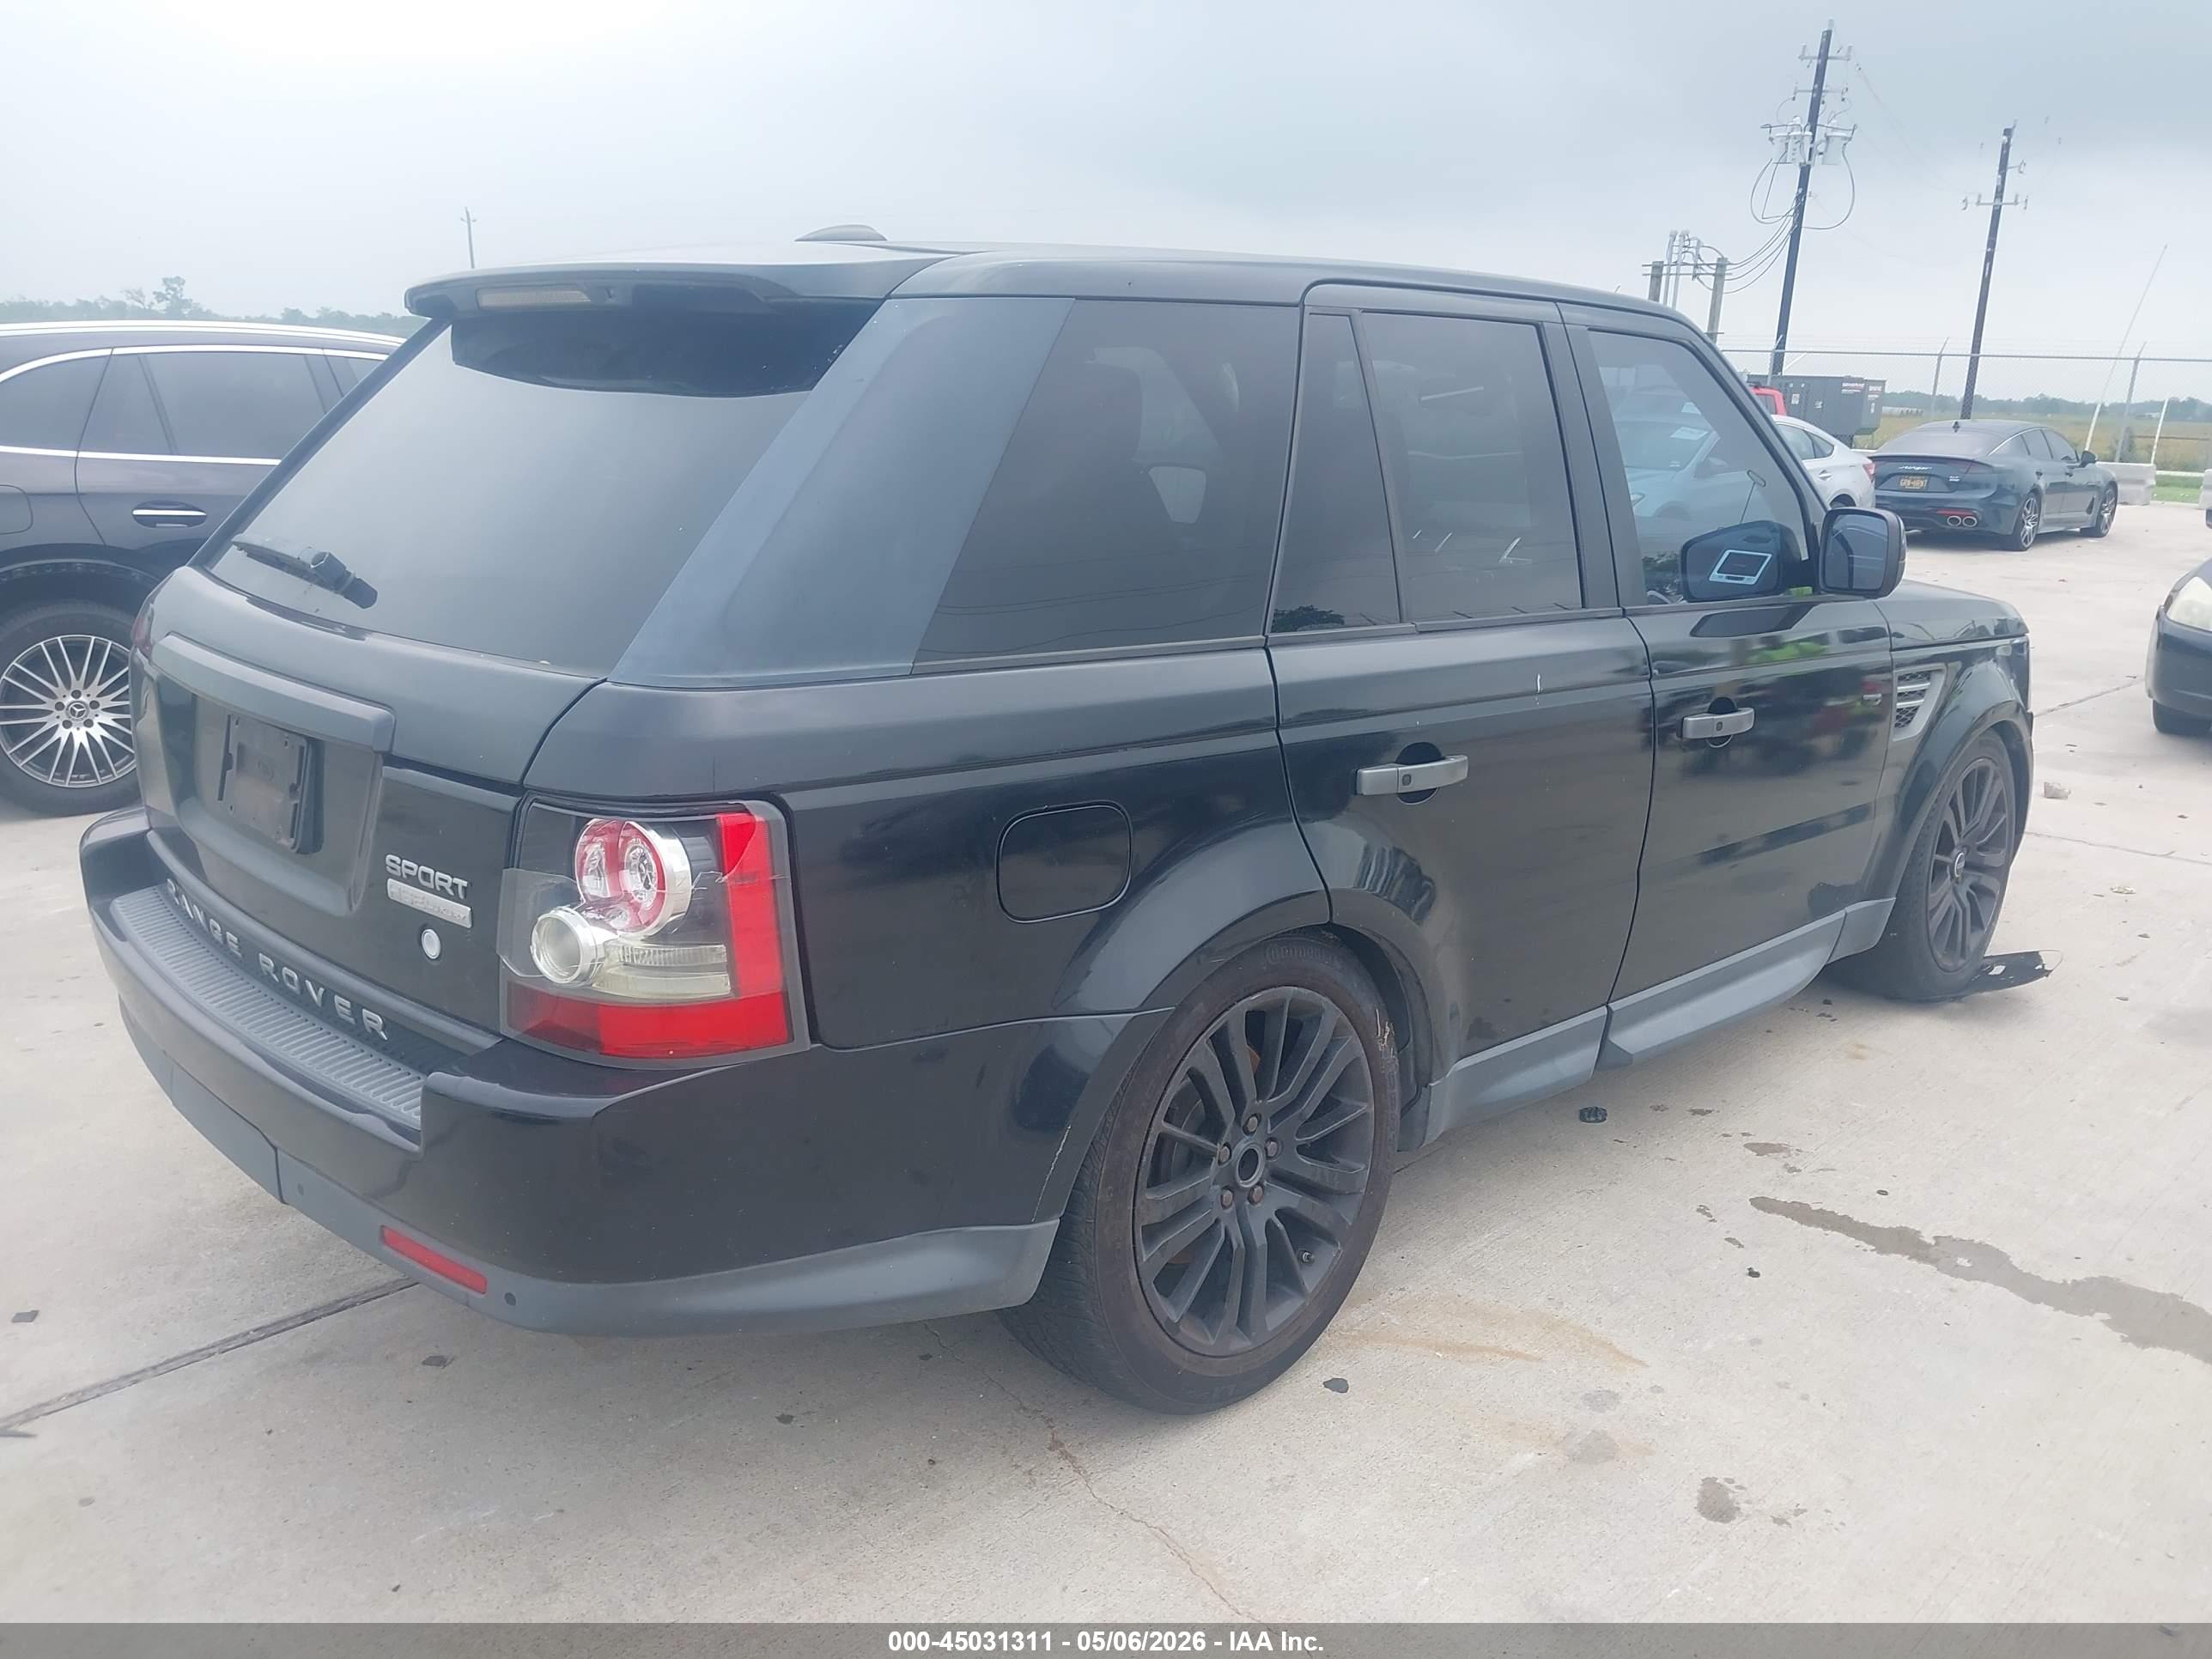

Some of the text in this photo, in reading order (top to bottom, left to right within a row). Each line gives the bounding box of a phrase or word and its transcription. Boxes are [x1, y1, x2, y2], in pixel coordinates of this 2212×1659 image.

[386, 854, 468, 900] SPORT
[167, 878, 388, 1041] RANGE ROVER
